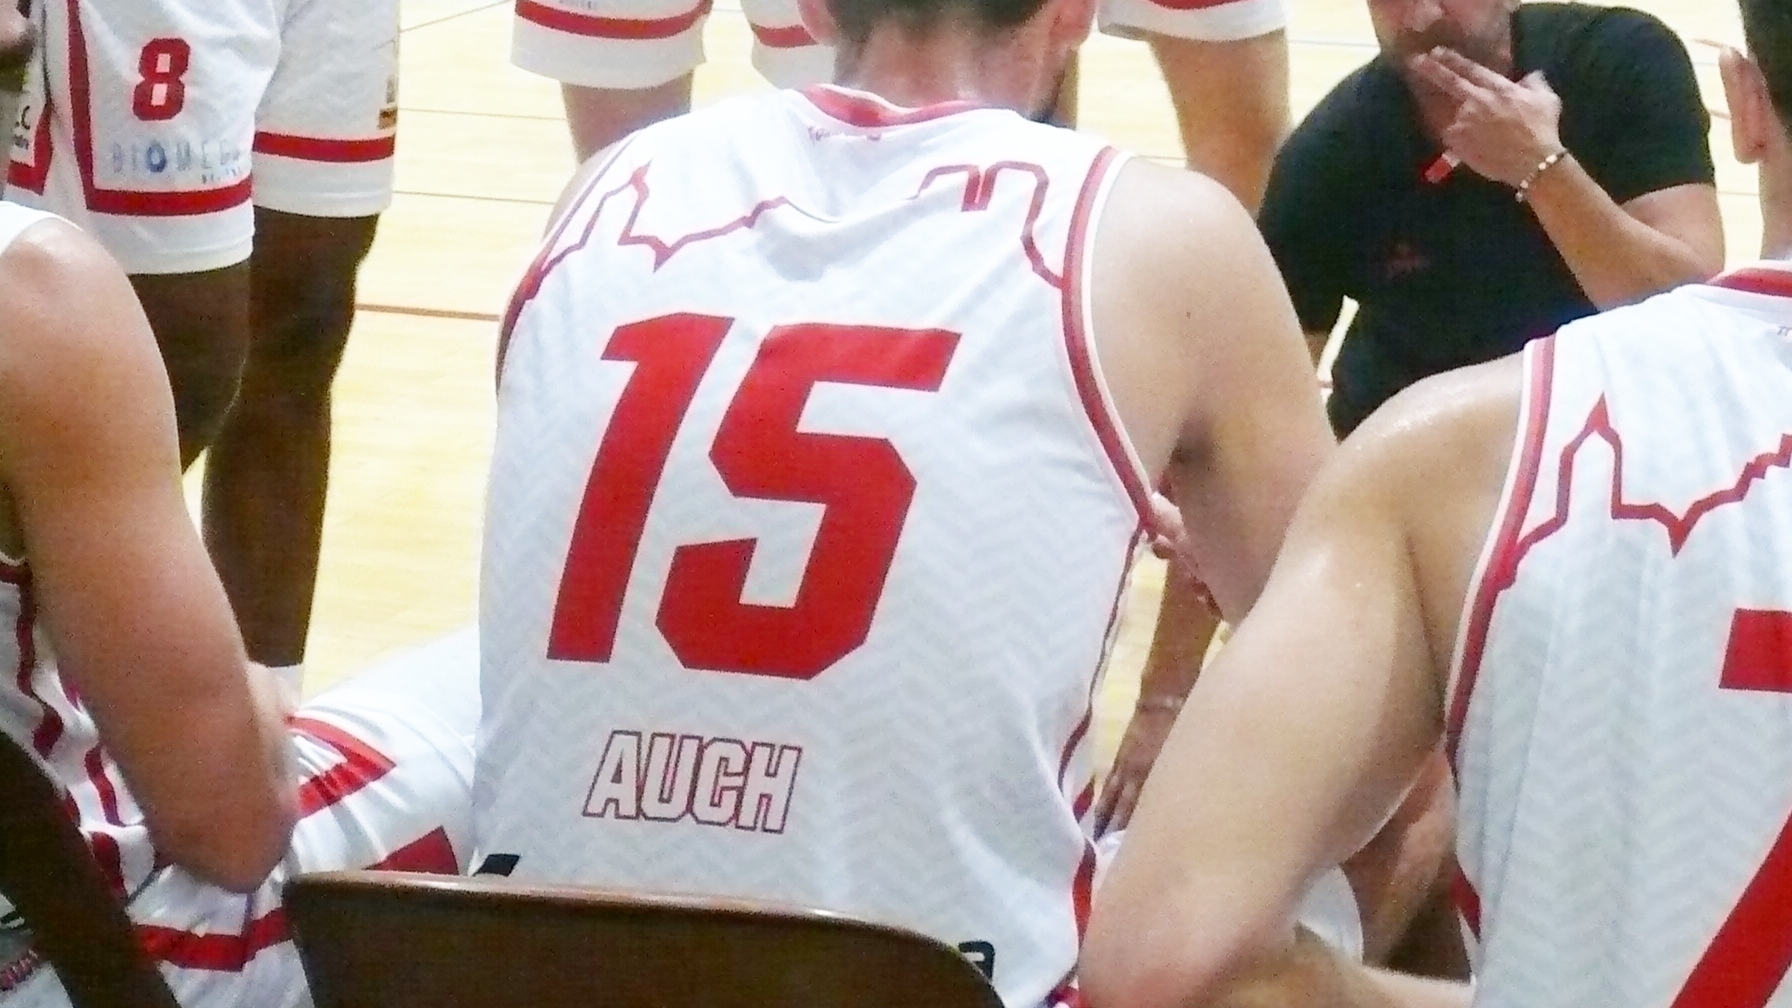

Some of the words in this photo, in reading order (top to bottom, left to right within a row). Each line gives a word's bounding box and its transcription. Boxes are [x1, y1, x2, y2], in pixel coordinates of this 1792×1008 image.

[132, 37, 191, 121] 8
[546, 311, 962, 681] 15
[582, 730, 803, 834] AUCH
